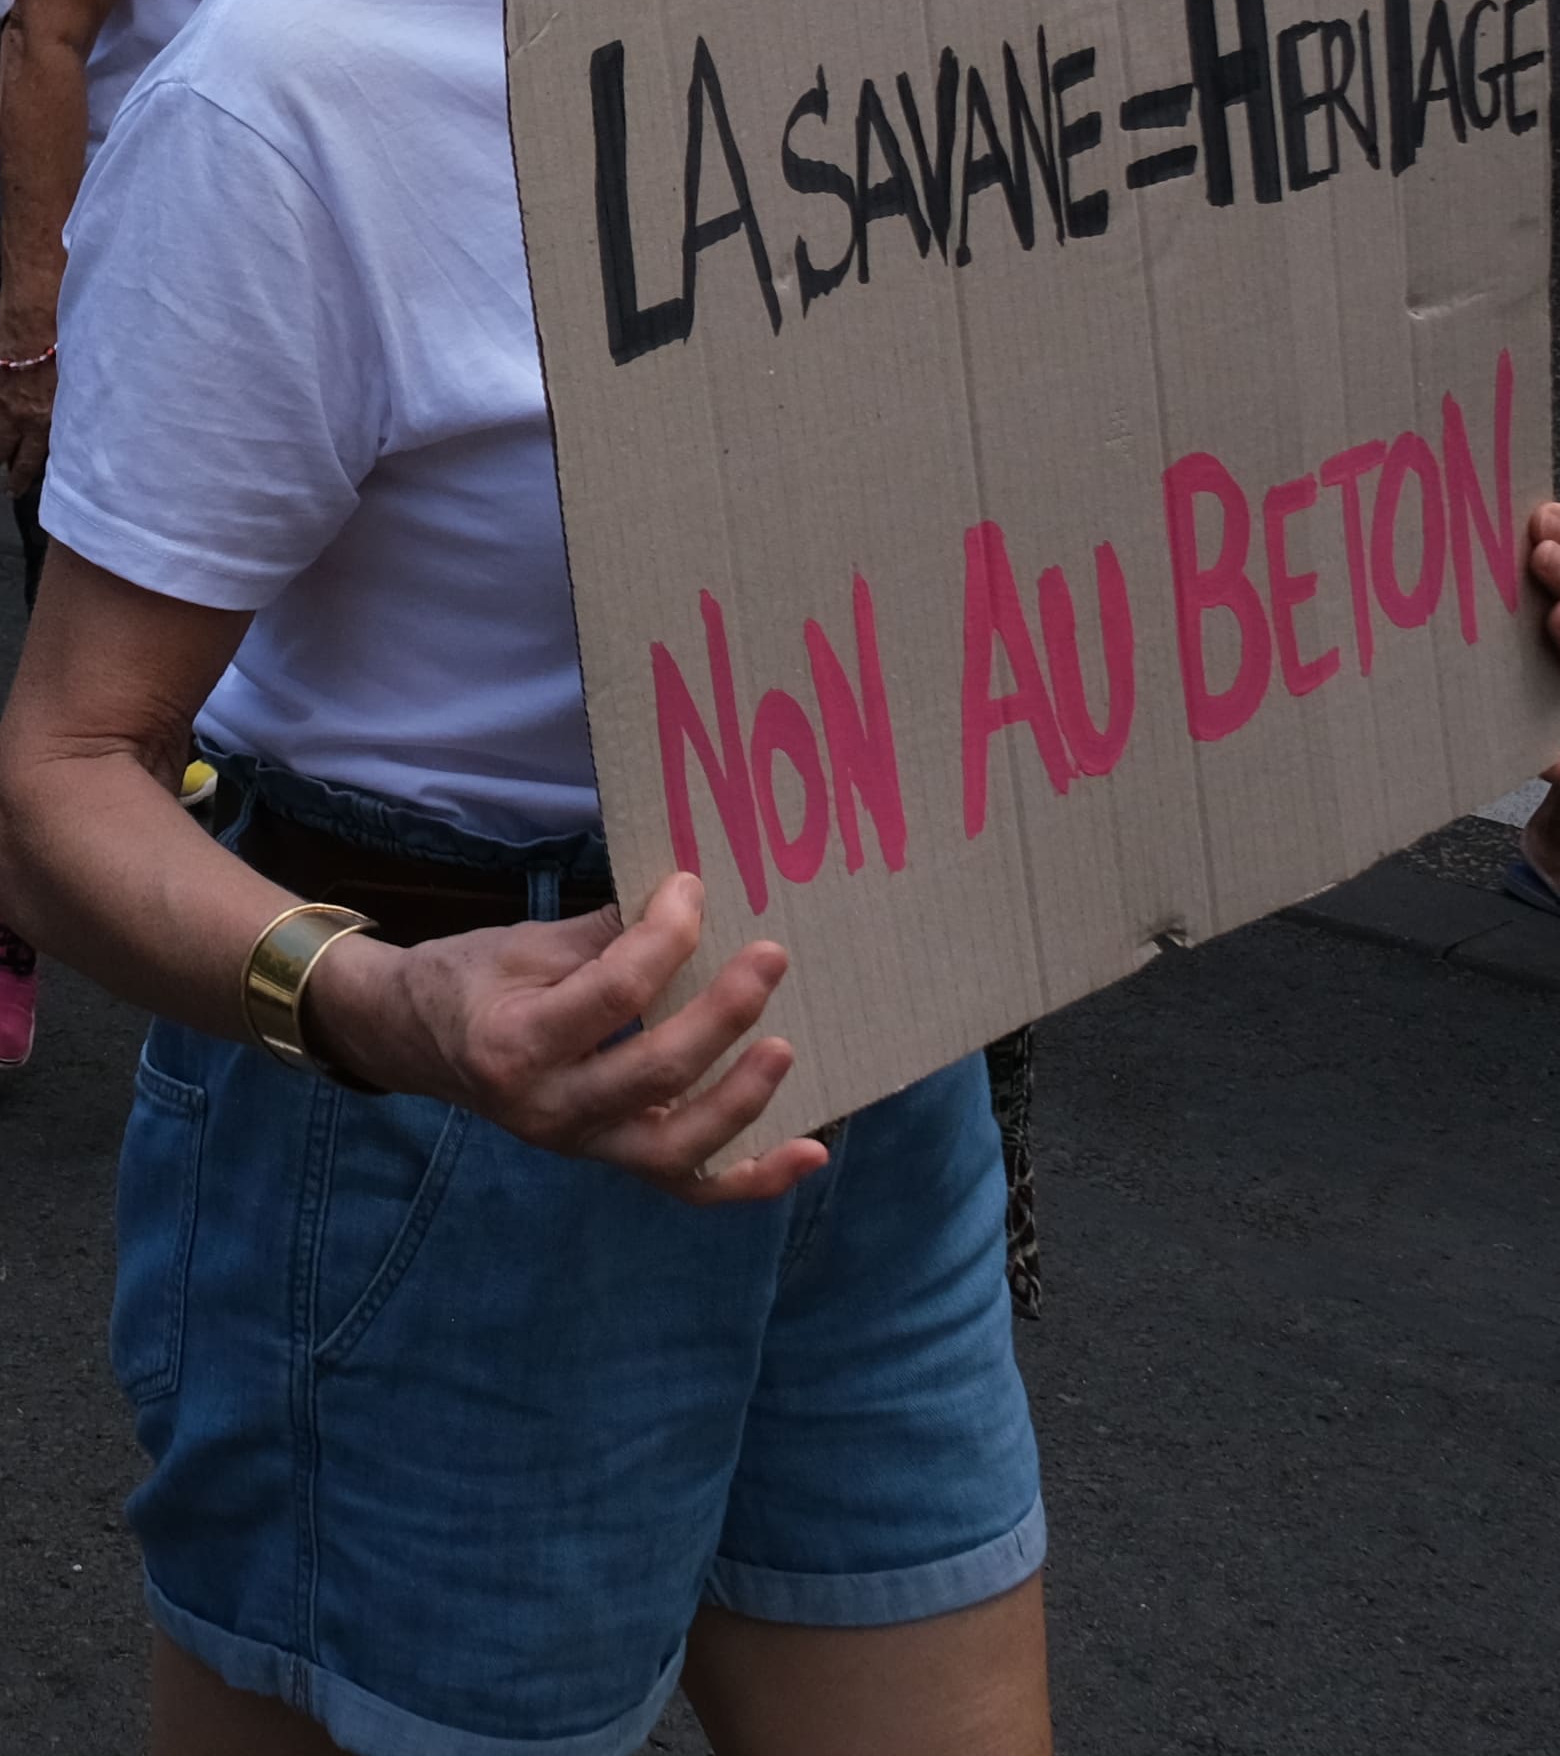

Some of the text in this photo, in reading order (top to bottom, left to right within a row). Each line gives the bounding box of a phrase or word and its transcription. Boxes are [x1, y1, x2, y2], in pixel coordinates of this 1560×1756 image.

[587, 34, 784, 367] LA
[959, 518, 1136, 841] AU
[1162, 346, 1522, 745] BETON
